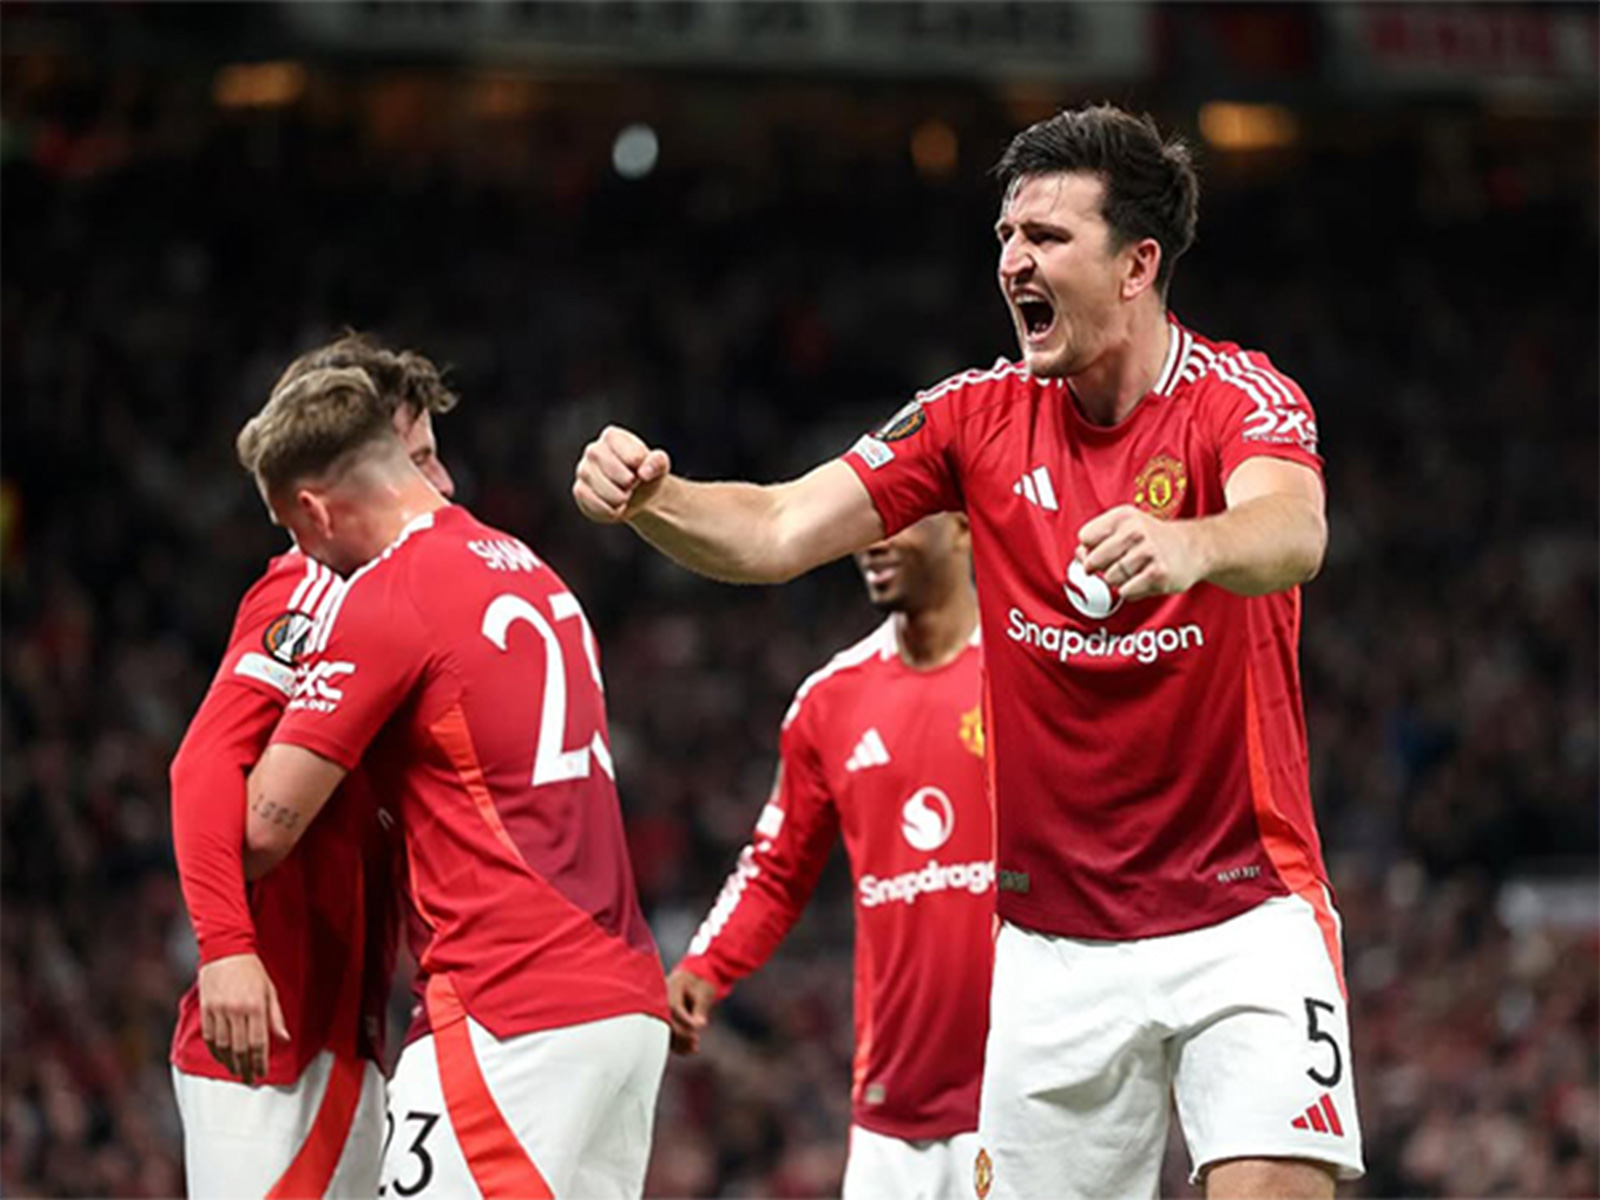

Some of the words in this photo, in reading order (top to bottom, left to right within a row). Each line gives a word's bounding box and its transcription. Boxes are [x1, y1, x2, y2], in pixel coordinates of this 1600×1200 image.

[1007, 607, 1204, 664] Snapdragon
[859, 858, 996, 908] Snapdrag
[1304, 997, 1343, 1088] 5
